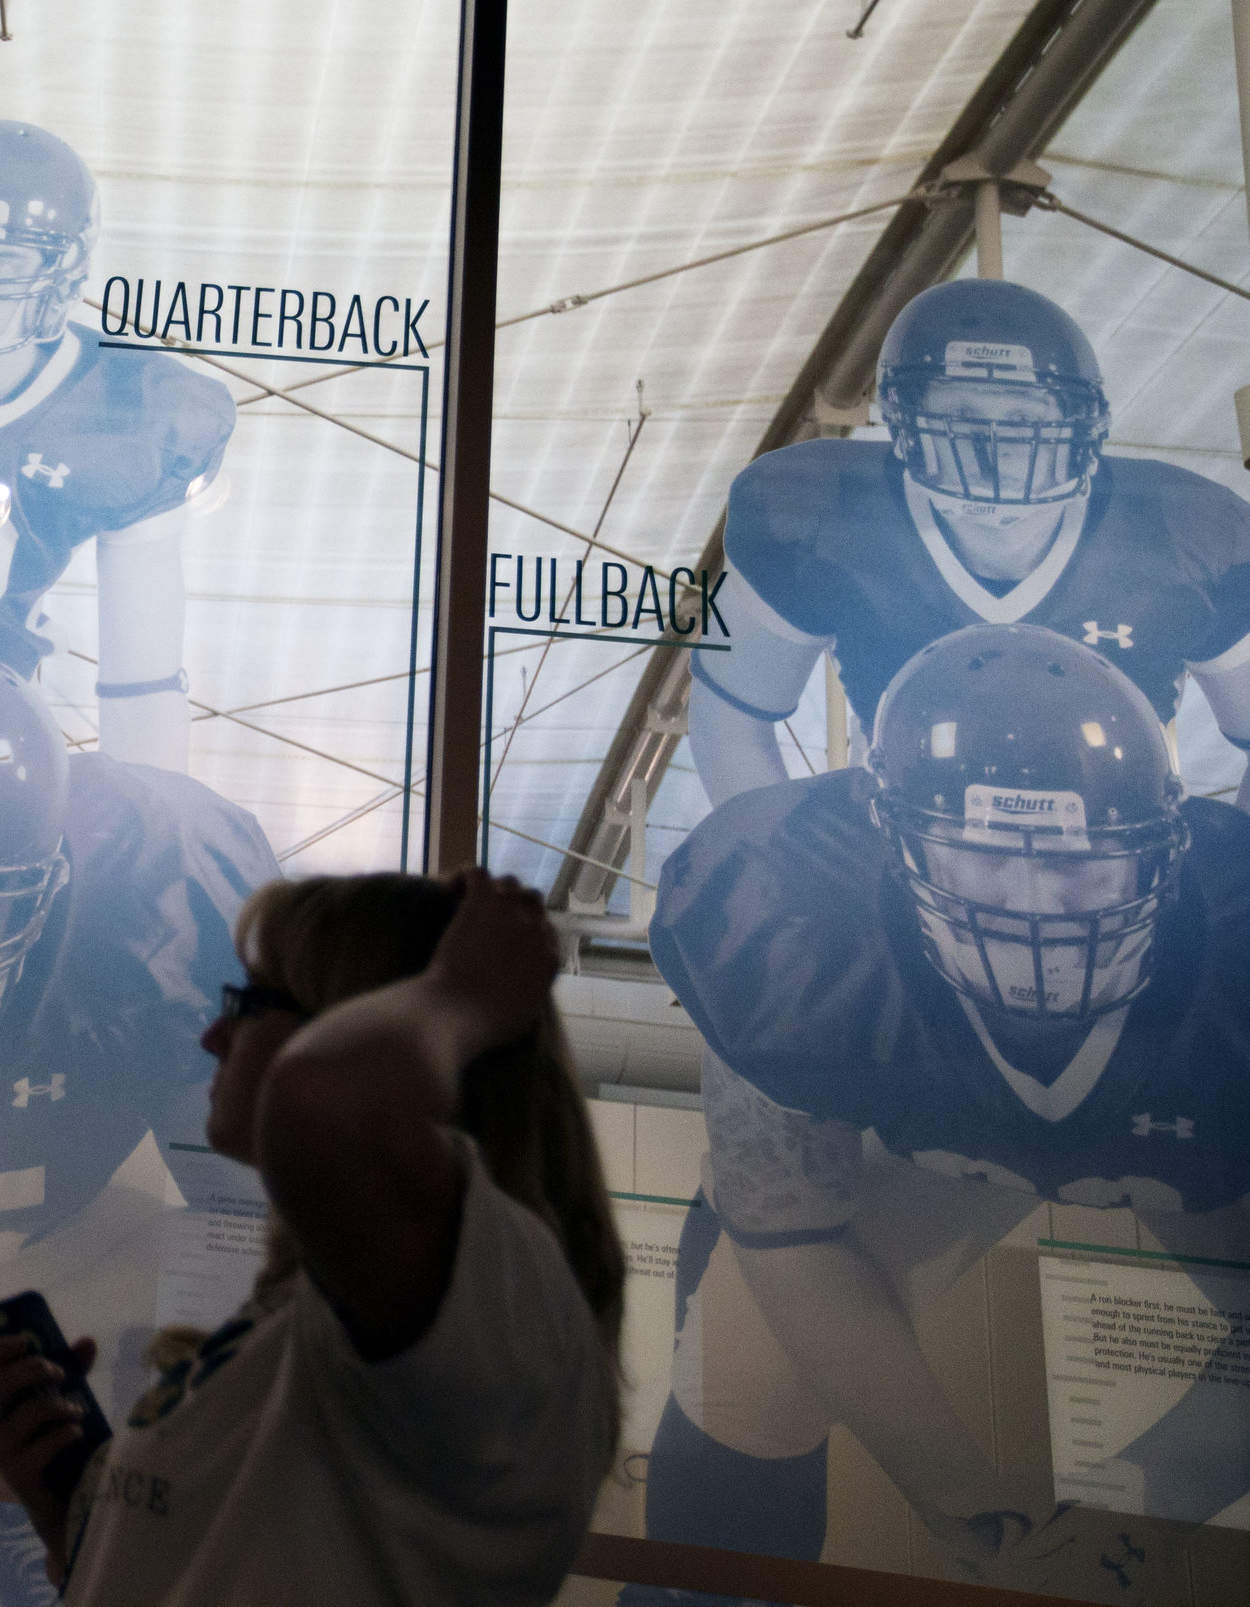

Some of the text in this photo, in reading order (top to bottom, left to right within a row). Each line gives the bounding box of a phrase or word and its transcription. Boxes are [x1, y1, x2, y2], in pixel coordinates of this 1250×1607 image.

[100, 275, 431, 359] QUARTERBACK
[965, 345, 1012, 360] schutt
[488, 553, 731, 638] FULLBACK
[993, 794, 1055, 813] schutt
[1008, 984, 1060, 1004] schtt
[1090, 1294, 1096, 1303] A
[1114, 1296, 1141, 1307] blocker
[1144, 1300, 1162, 1311] first,
[1164, 1302, 1174, 1311] he
[1176, 1305, 1196, 1313] must
[1198, 1306, 1208, 1316] be
[1228, 1311, 1243, 1320] and
[1091, 1309, 1120, 1319] enough
[1123, 1311, 1131, 1319] to
[1133, 1313, 1155, 1324] sprint
[1157, 1315, 1175, 1325] from
[1177, 1318, 1189, 1327] his
[1192, 1320, 1217, 1330] stance
[1220, 1324, 1228, 1332] to
[1231, 1326, 1243, 1335] get
[1092, 1321, 1116, 1331] ahead
[1118, 1324, 1126, 1332] of
[1129, 1325, 1141, 1334] the
[1143, 1328, 1174, 1339] running
[1176, 1330, 1194, 1340] back
[1197, 1334, 1205, 1342] to
[1207, 1334, 1226, 1344] clear
[1094, 1333, 1107, 1342] But
[1109, 1334, 1119, 1344] he
[1121, 1336, 1137, 1346] also
[1139, 1339, 1159, 1349] must
[1161, 1341, 1171, 1350] be
[1173, 1343, 1202, 1355] equally
[1094, 1347, 1135, 1359] protection.
[1139, 1352, 1155, 1361] He's
[1158, 1355, 1185, 1367] usually
[1204, 1360, 1212, 1369] of
[1214, 1360, 1228, 1371] the
[1095, 1360, 1110, 1369] and
[1113, 1362, 1132, 1371] most
[1134, 1364, 1166, 1376] physical
[1168, 1368, 1197, 1380] players
[1198, 1372, 1207, 1381] in
[1208, 1372, 1221, 1383] the
